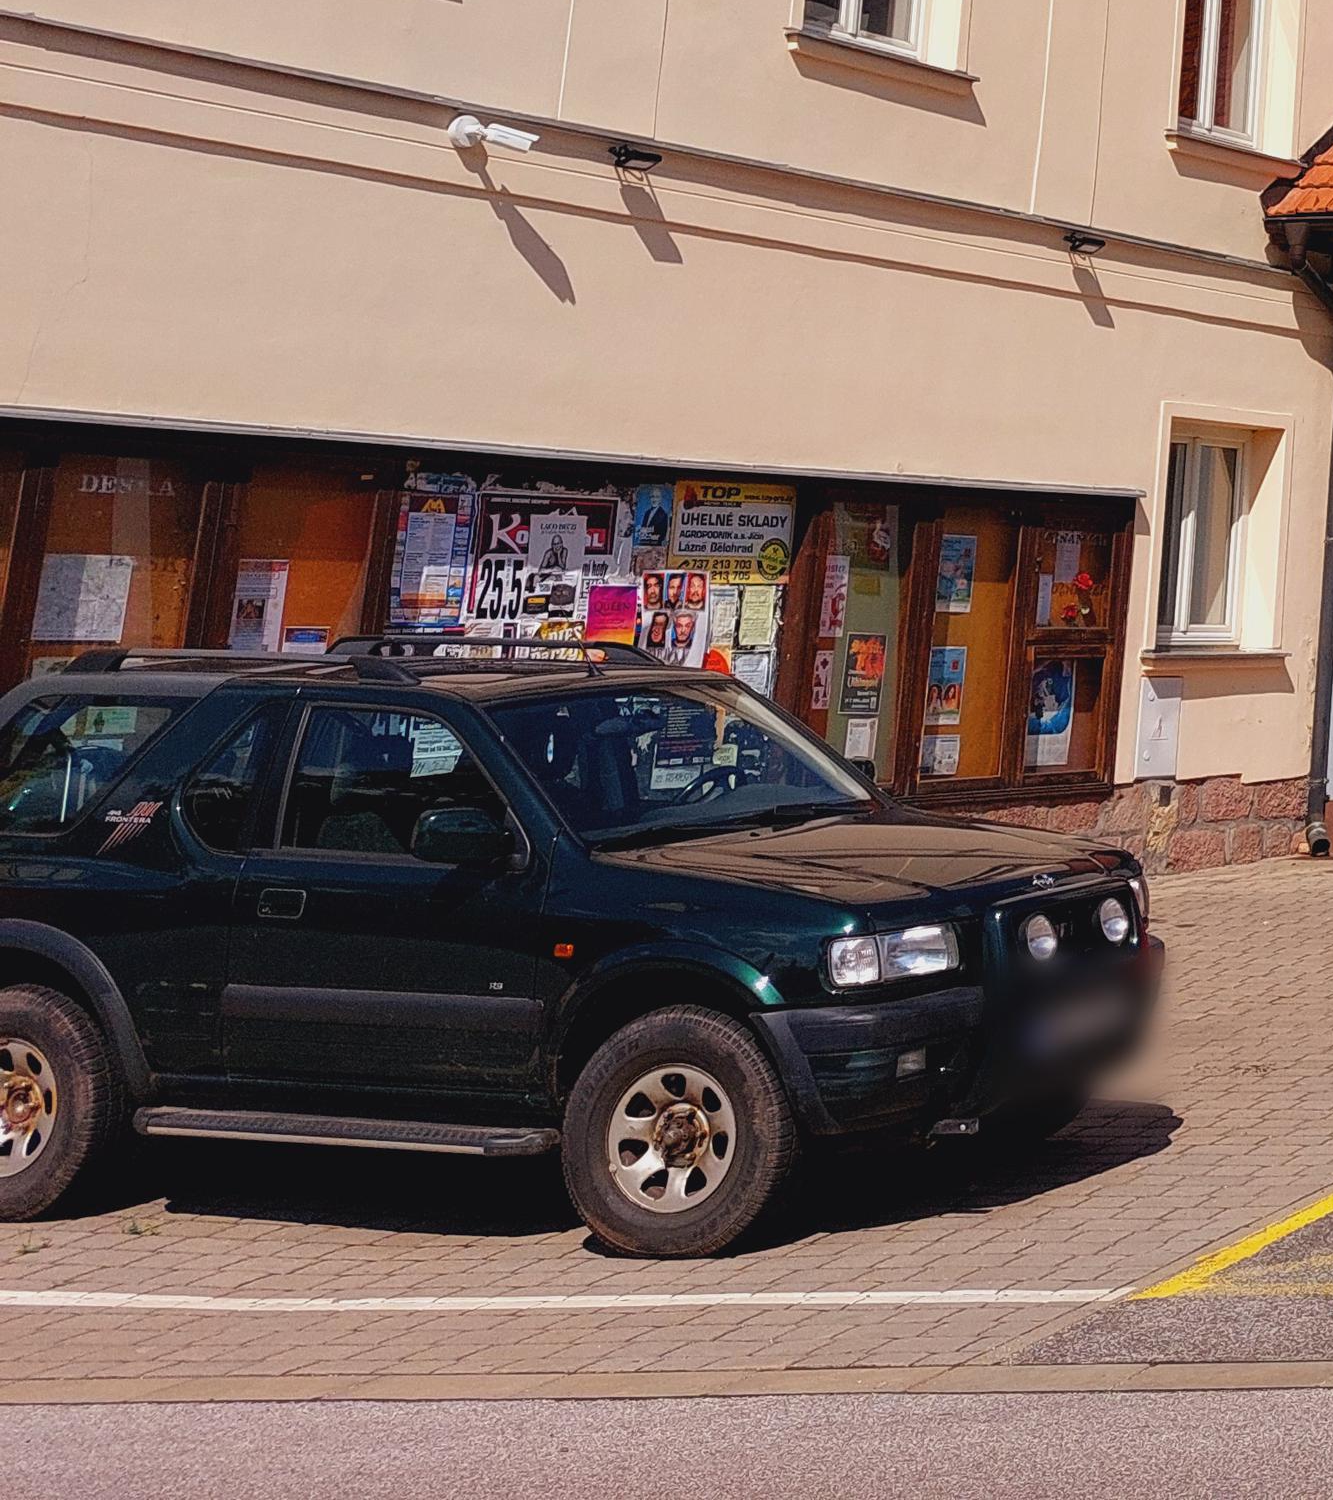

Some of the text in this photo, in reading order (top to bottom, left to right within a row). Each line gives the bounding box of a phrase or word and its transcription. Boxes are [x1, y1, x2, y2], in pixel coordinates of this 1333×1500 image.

[701, 485, 741, 500] TOP
[681, 512, 788, 528] UHELNÉ SKLADY
[691, 558, 752, 569] 737 213 703
[733, 571, 751, 581] 705
[594, 602, 630, 614] QUEEN
[104, 815, 151, 824] FRONTERA
